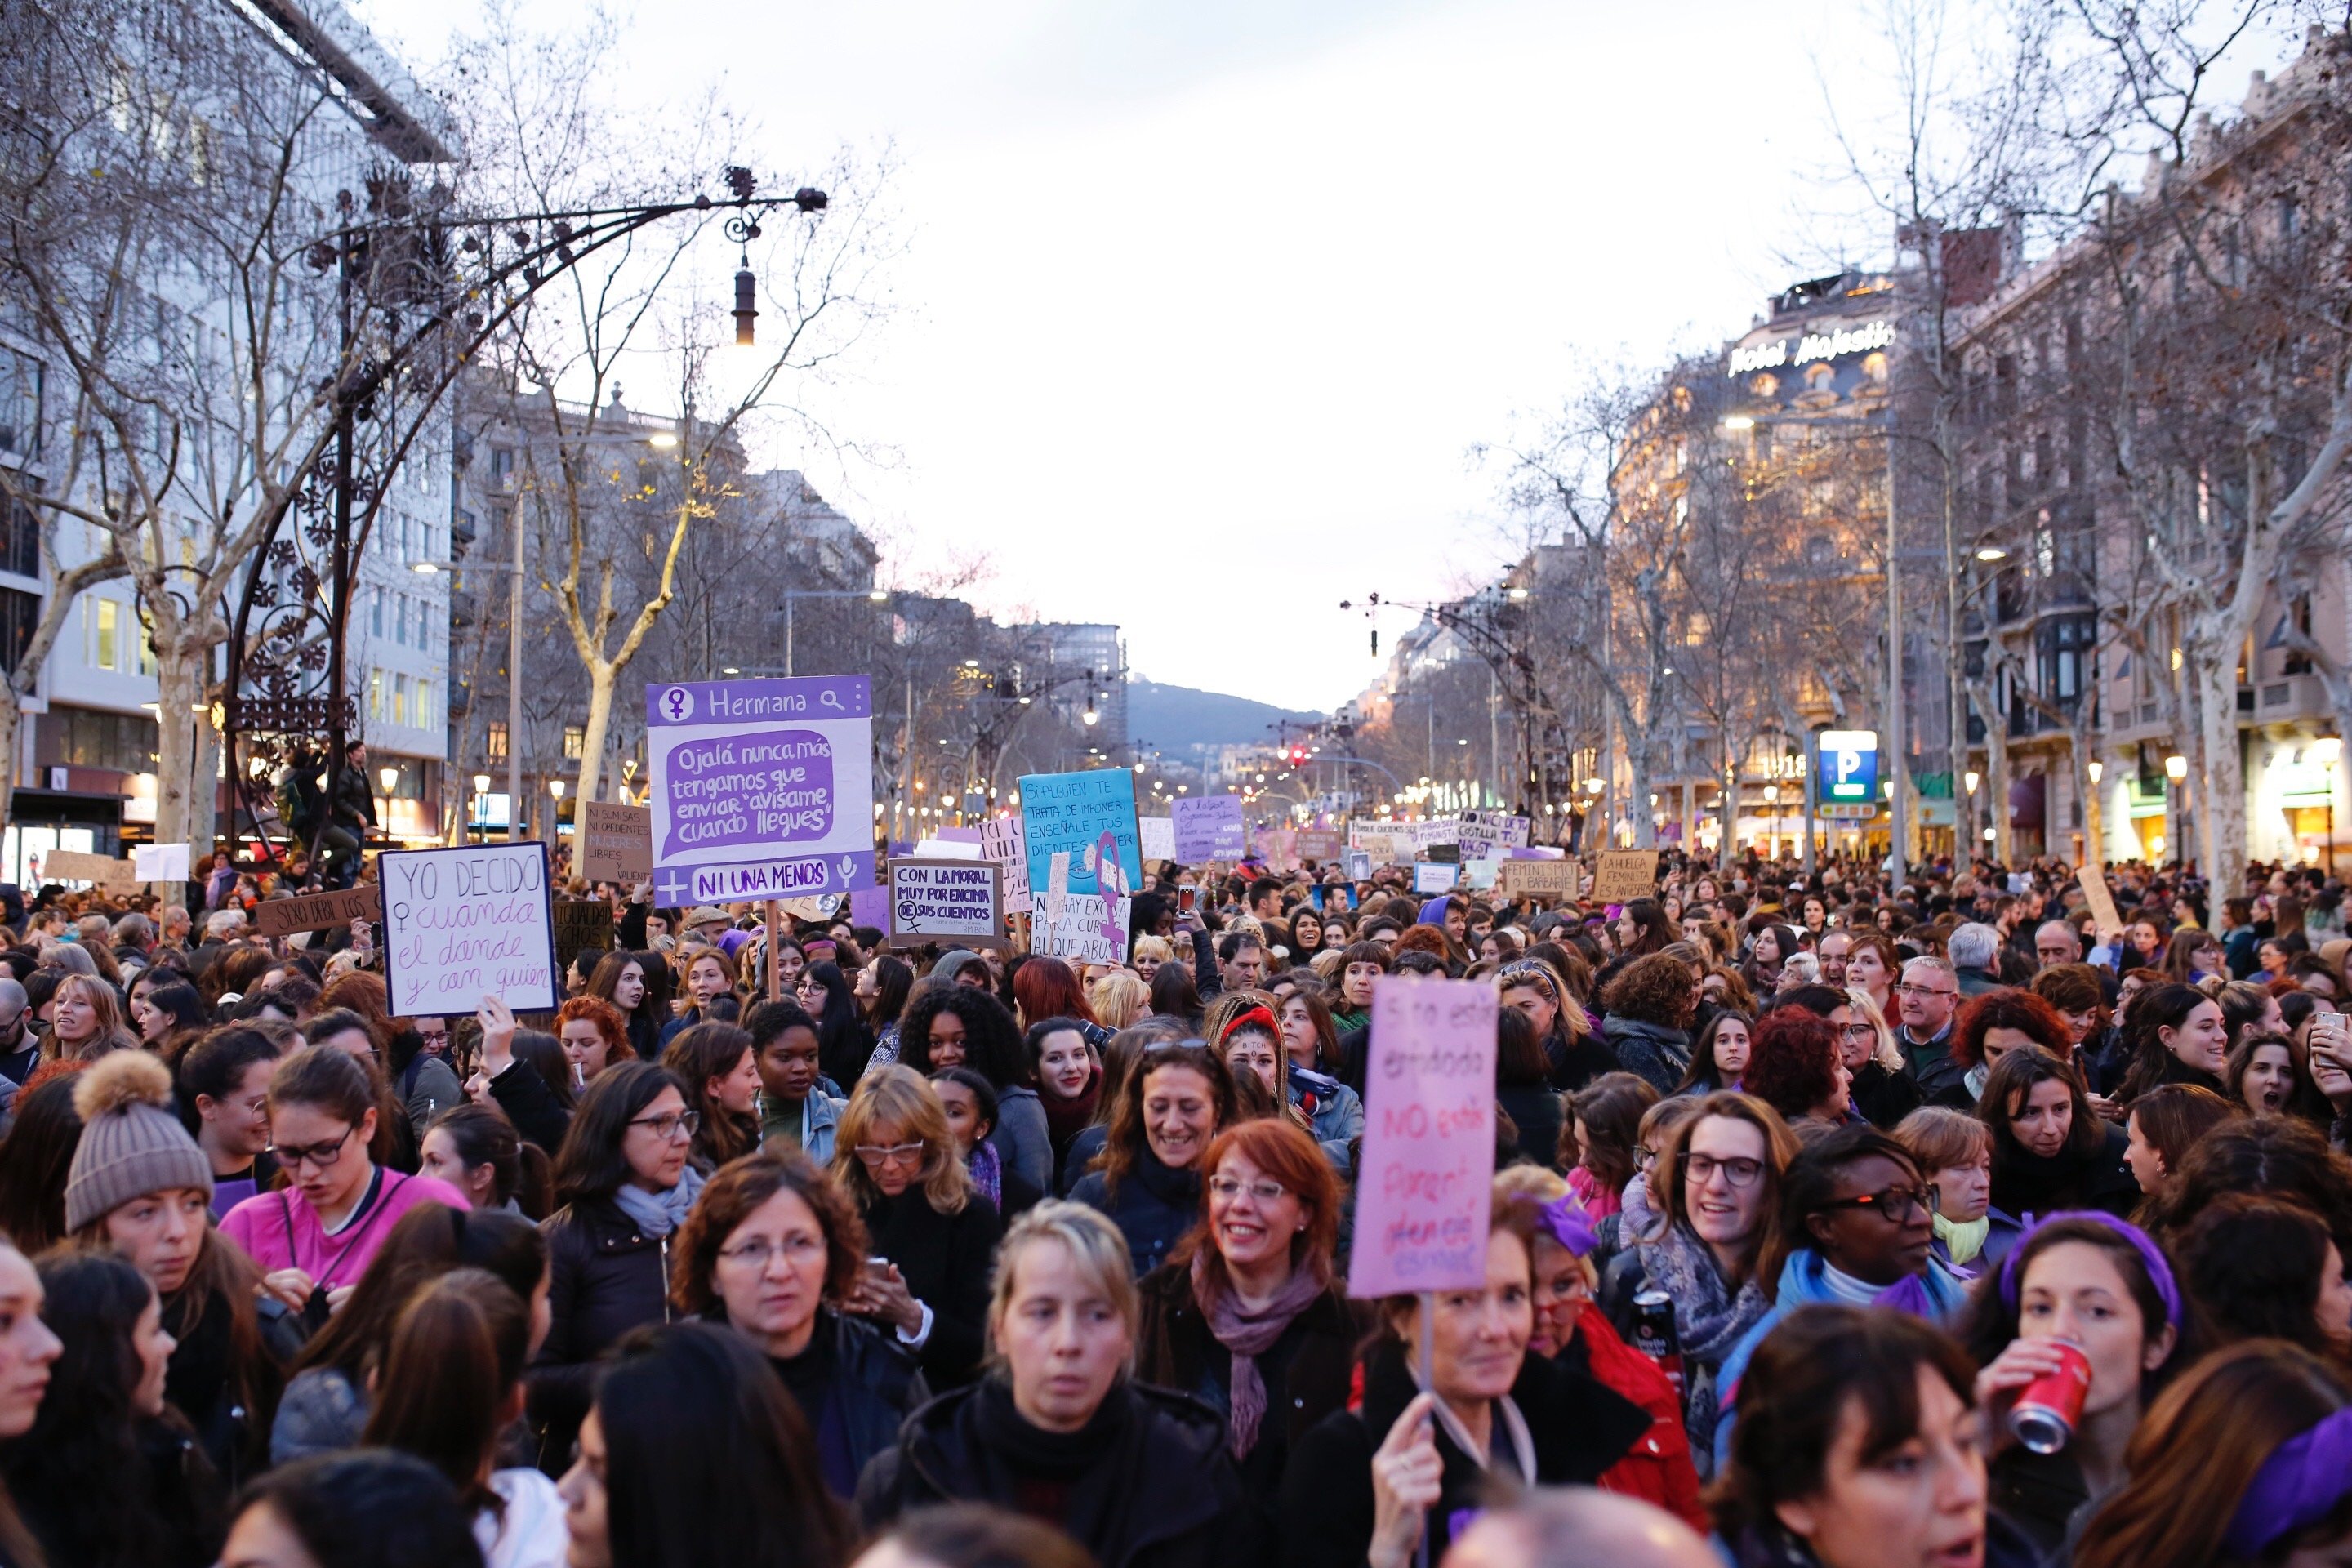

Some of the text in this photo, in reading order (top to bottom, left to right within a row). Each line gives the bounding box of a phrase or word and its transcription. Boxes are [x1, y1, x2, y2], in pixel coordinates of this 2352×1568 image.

[1727, 320, 1897, 378] Hotel Majestic
[710, 688, 807, 716] Hermana
[679, 738, 831, 775] Ojalá nunca más
[1838, 751, 1860, 783] P
[671, 766, 806, 800] tengamos que
[1095, 781, 1112, 793] TE
[590, 808, 640, 822] NI SUMISAS
[1027, 805, 1060, 819] TRATA
[1066, 804, 1076, 816] DE
[1459, 811, 1477, 822] NO
[1505, 817, 1515, 829] DE
[589, 821, 598, 831] NI
[678, 813, 748, 843] cuando
[1030, 817, 1123, 839] ENSEÑALE TUS
[398, 854, 541, 900] YO DECIDO
[617, 871, 652, 881] VALIENT
[898, 868, 928, 883] CON
[935, 870, 950, 884] LA
[951, 870, 990, 884] MORAL
[1507, 864, 1574, 876] FEMINISMO
[1606, 871, 1650, 882] FEMINISTA
[698, 862, 825, 898] NI UNA MENOS
[1527, 878, 1573, 890] BARBARIE
[898, 886, 990, 904] MUY POR ENCIMA
[1599, 884, 1612, 898] ES
[276, 902, 308, 930] SEXO
[341, 895, 366, 919] LOS
[559, 904, 612, 926] IGUALDAD
[901, 904, 990, 920] DE SUS CUENTOS
[1085, 899, 1127, 918] EXCSA
[399, 935, 428, 969] el
[1034, 937, 1049, 956] AL
[405, 978, 430, 1006] y
[439, 968, 483, 993] con
[1383, 1101, 1428, 1139] NO
